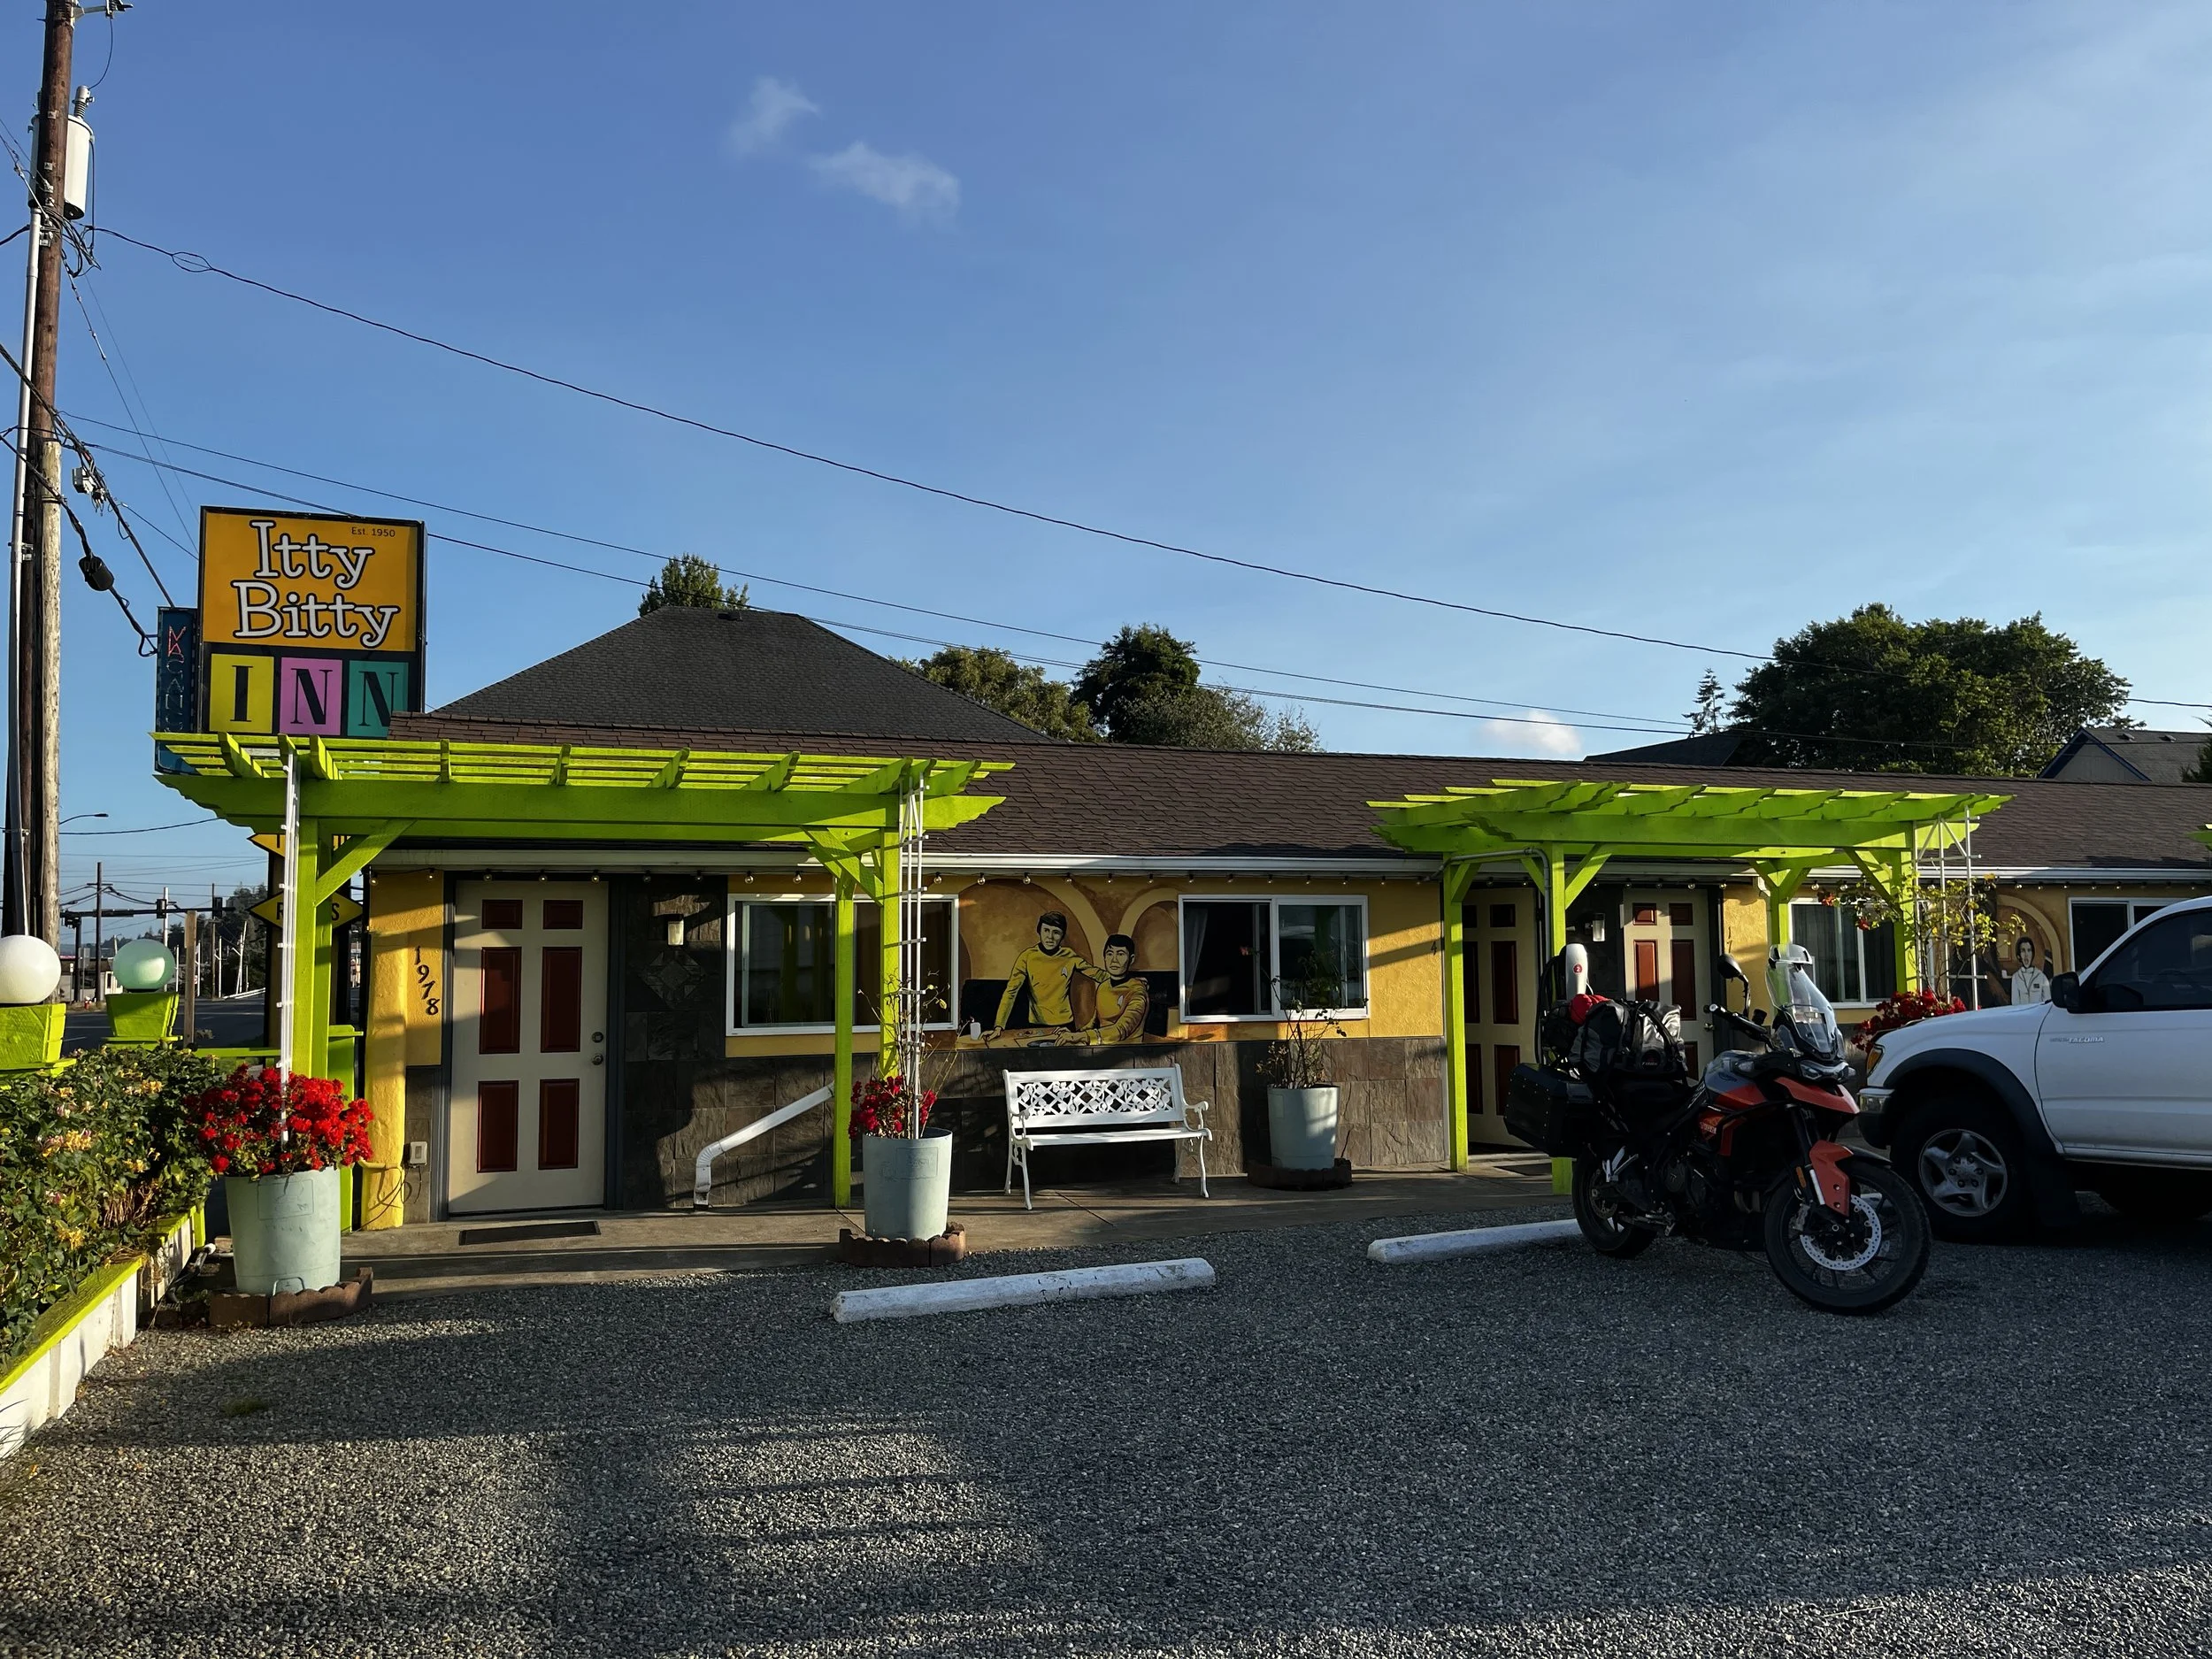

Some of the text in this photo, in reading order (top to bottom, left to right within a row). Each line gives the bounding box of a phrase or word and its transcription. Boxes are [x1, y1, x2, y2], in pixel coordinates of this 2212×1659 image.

[250, 520, 375, 588] Itty
[372, 528, 396, 538] 1950
[231, 580, 401, 648] Bitty
[229, 664, 399, 726] INN
[413, 945, 441, 1016] 1978
[1430, 941, 1438, 956] 4
